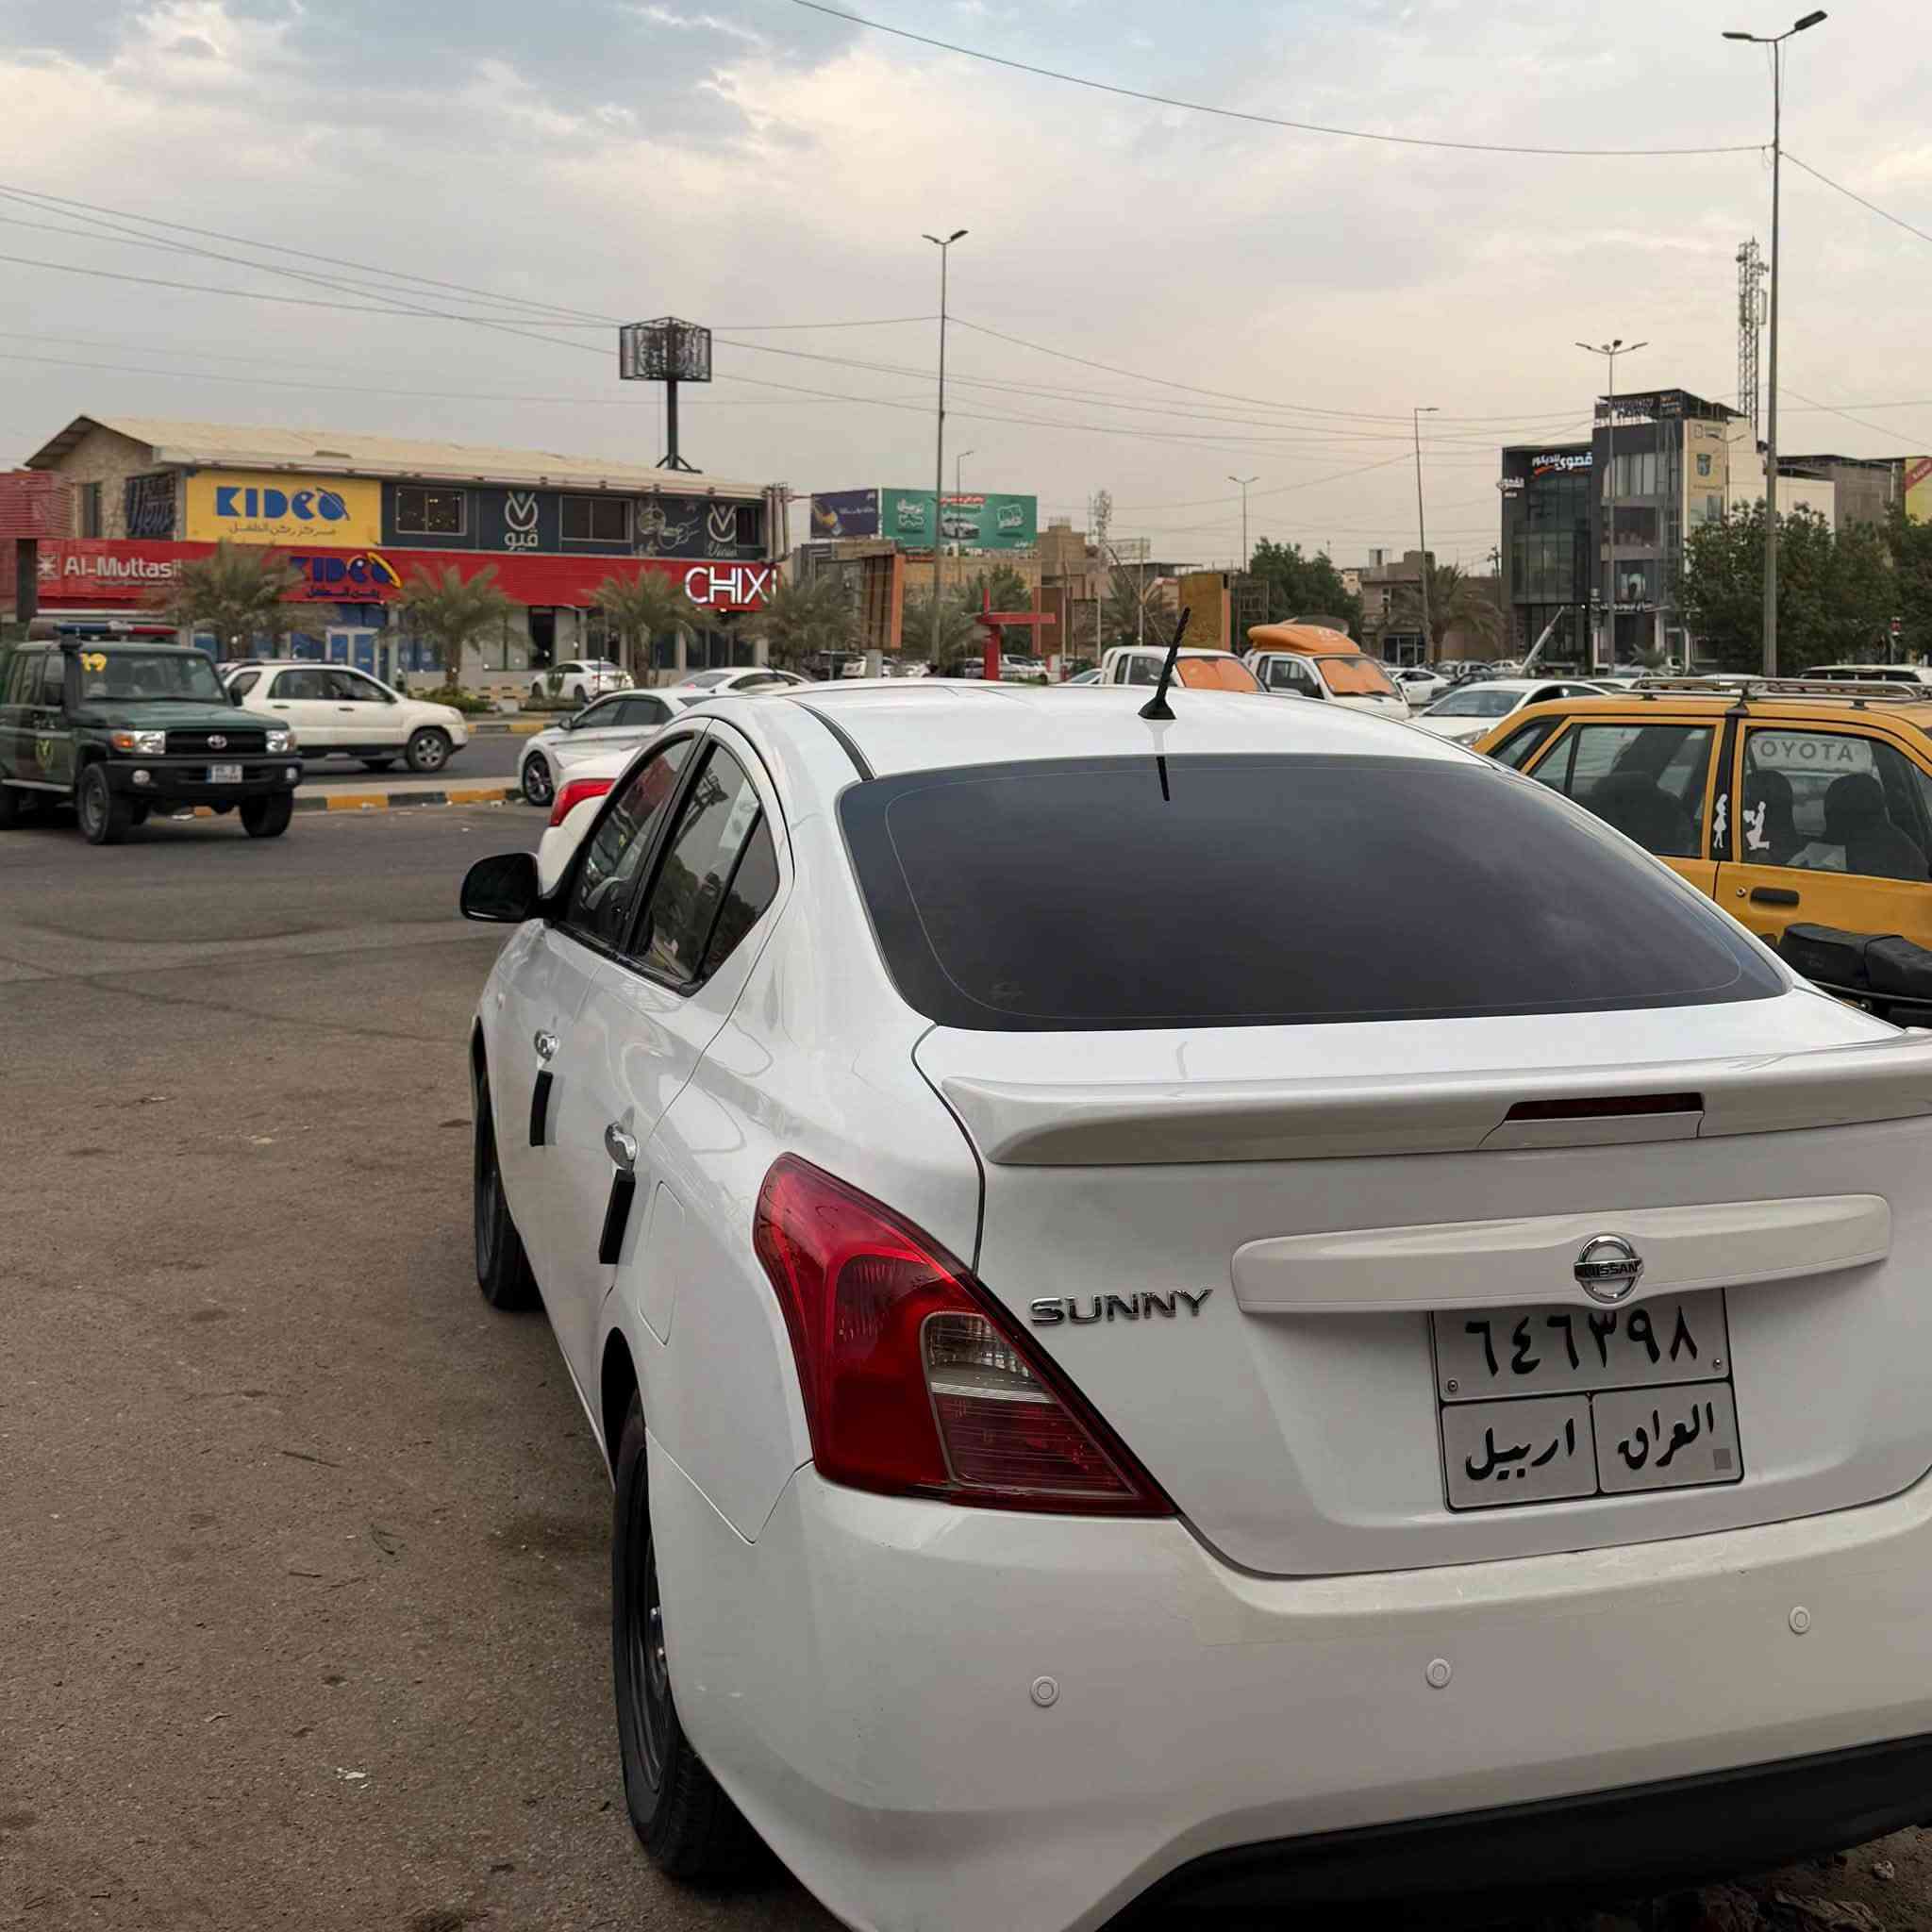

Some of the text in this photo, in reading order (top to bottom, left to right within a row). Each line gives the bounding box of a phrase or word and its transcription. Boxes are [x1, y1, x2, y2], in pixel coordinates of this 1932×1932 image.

[216, 486, 350, 521] KIDCO
[1752, 739, 1854, 762] OYOTA
[1585, 1260, 1640, 1277] NISSAN
[1030, 1289, 1213, 1326] SUNNY
[1465, 1305, 1698, 1377] ٦٤٦٣٩٨
[1465, 1417, 1575, 1481] اربيل
[1617, 1402, 1715, 1470] العراق
